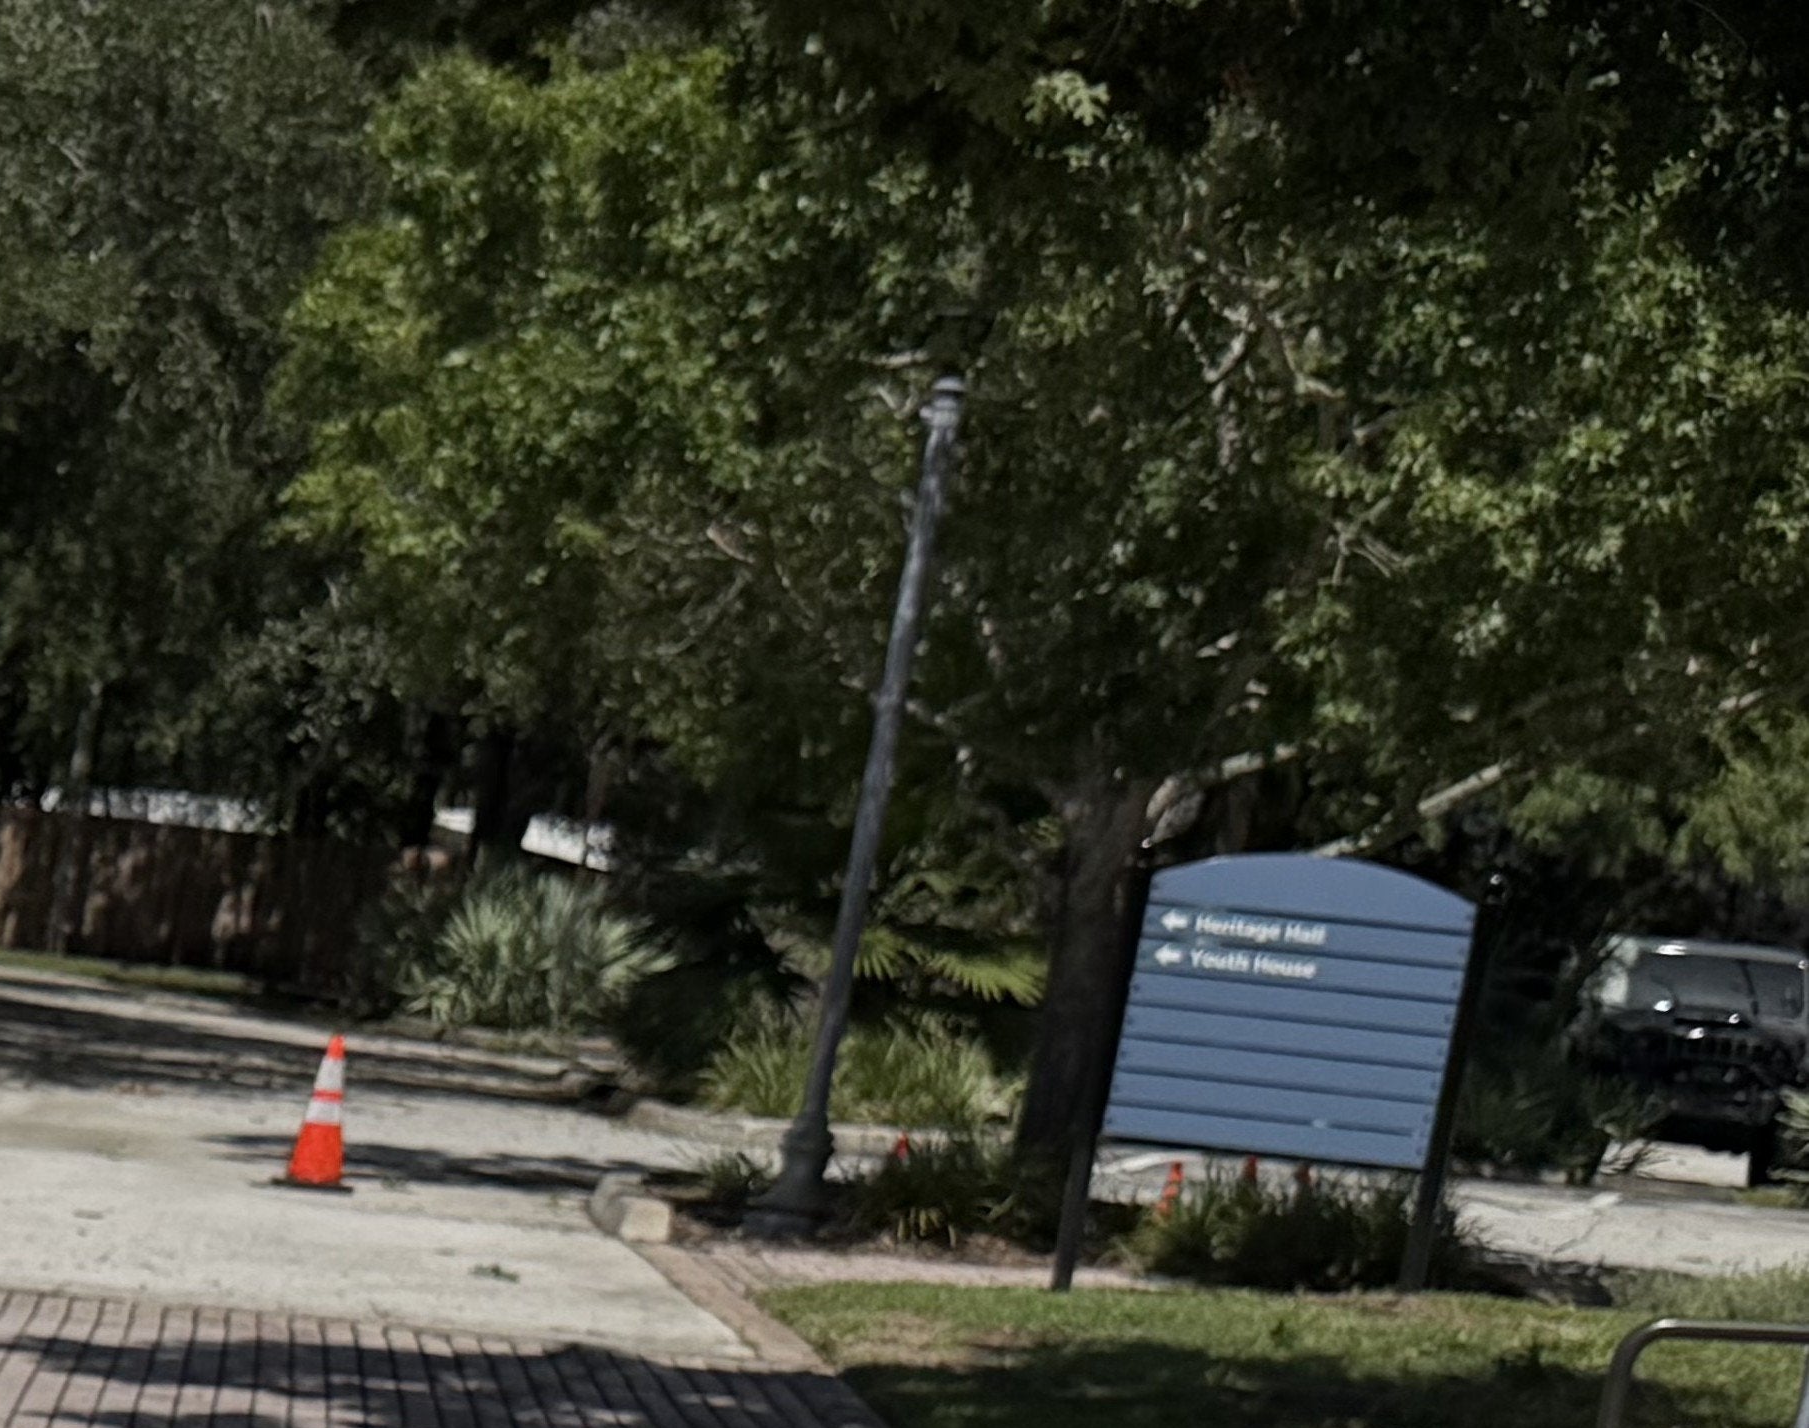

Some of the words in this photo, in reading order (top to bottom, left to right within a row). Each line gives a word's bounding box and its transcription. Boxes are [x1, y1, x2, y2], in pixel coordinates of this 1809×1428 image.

[1195, 914, 1280, 943] Heritage
[1284, 922, 1327, 945] Hall
[1191, 949, 1250, 973] Youth
[1253, 953, 1317, 979] House
